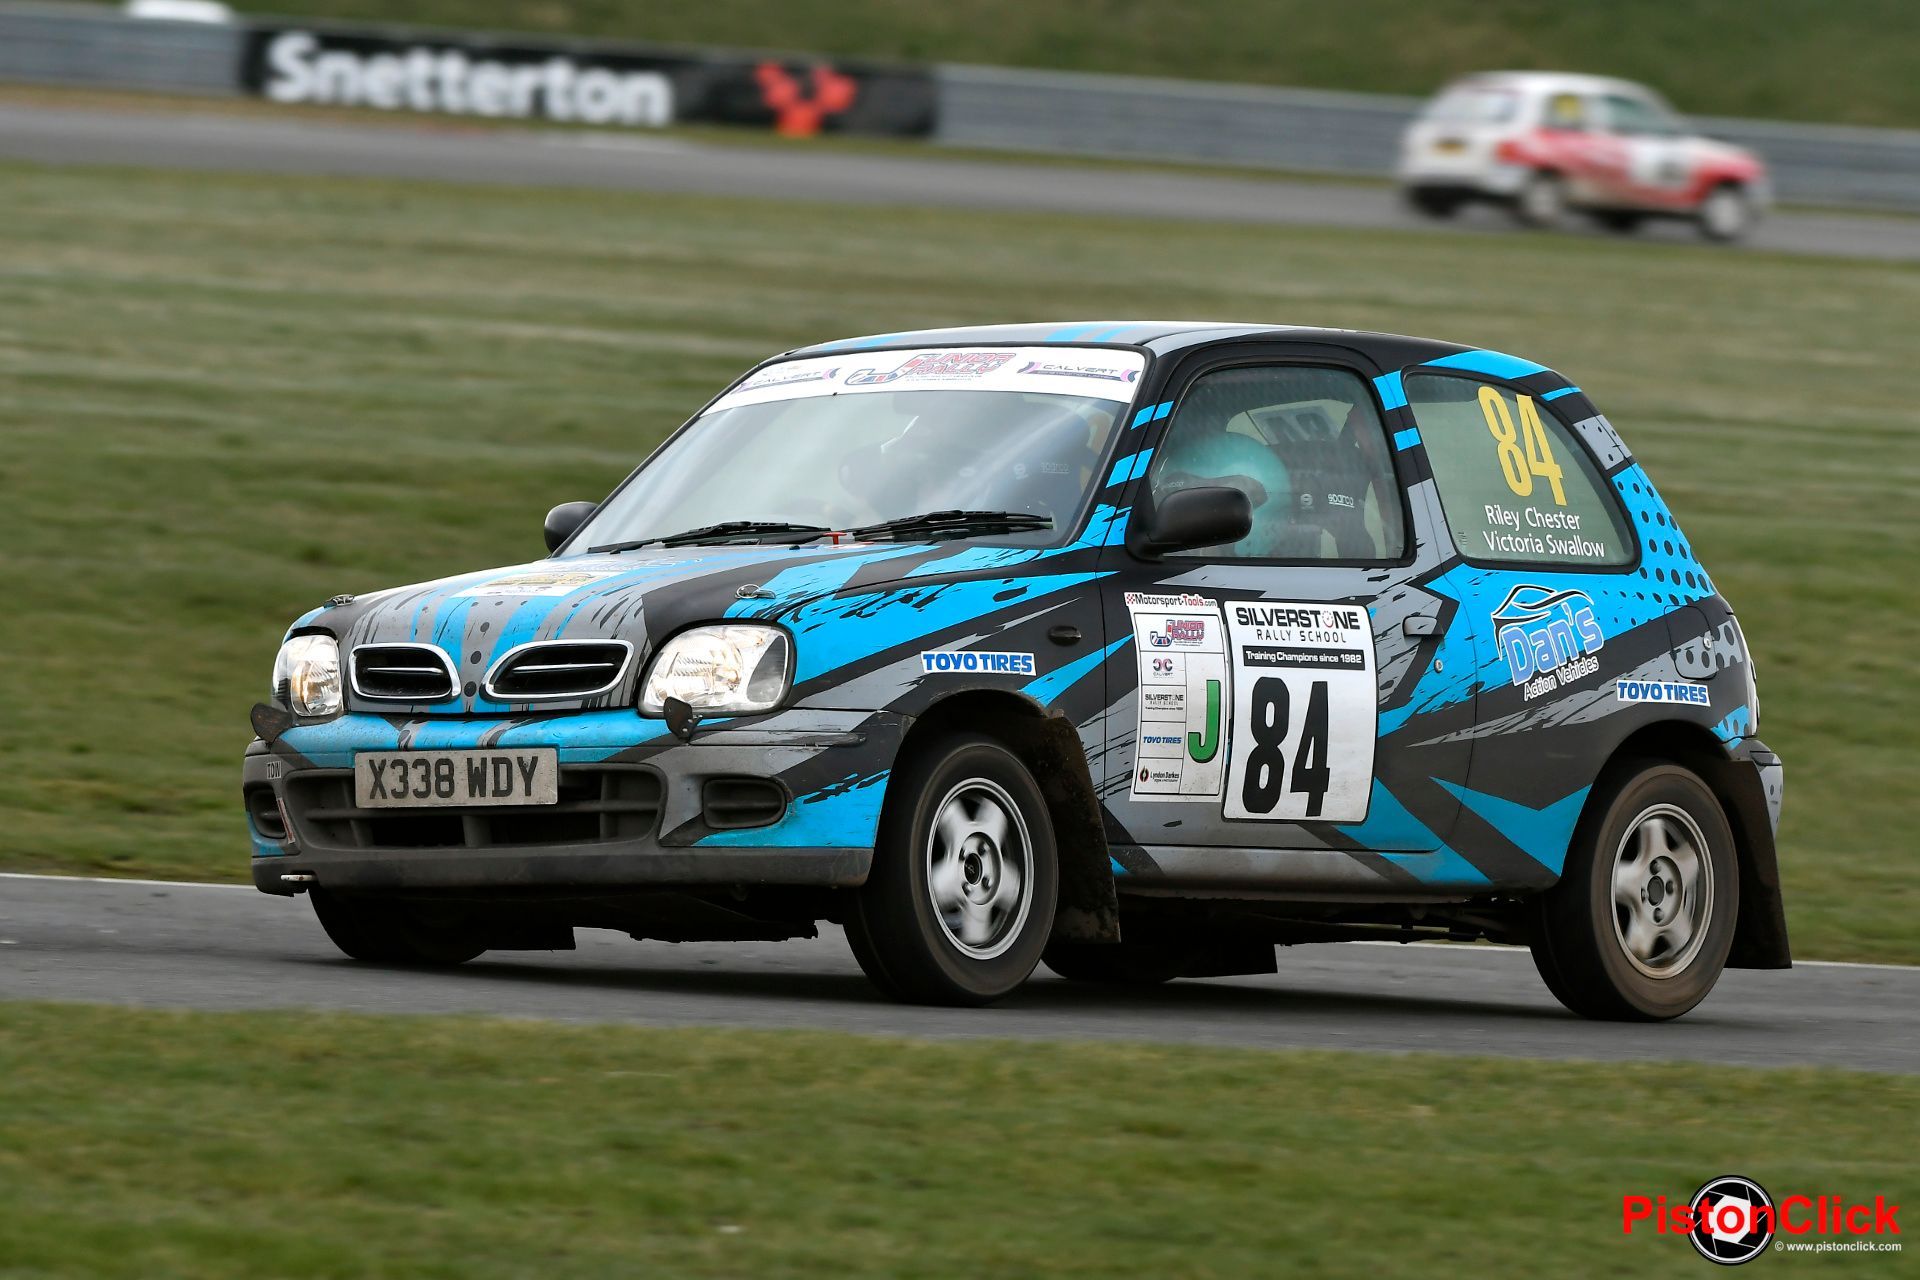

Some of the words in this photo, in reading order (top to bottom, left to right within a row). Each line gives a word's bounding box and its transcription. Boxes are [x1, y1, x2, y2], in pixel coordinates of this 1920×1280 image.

[266, 32, 674, 126] Snetterton
[1043, 364, 1119, 375] CALVERT
[1478, 385, 1567, 506] 84
[1484, 504, 1520, 531] Riley
[1525, 507, 1581, 529] Chester
[1483, 530, 1545, 553] Victoria
[1546, 534, 1604, 557] Swallow
[1235, 606, 1361, 630] SILVERSTONE
[1256, 629, 1291, 641] RALLY
[1299, 631, 1347, 643] SCHOOL
[1500, 602, 1605, 686] Dan's
[923, 652, 978, 671] TOYO
[979, 653, 1033, 673] TIRES
[1245, 650, 1277, 662] Training
[1276, 651, 1319, 663] Champions
[1319, 653, 1339, 663] since
[1340, 653, 1362, 664] 1982
[1524, 674, 1558, 702] Action
[1556, 655, 1599, 686] Vehicles
[1618, 682, 1663, 700] TOYO
[1664, 684, 1708, 704] TIRES
[1187, 679, 1221, 764] J
[1143, 736, 1162, 744] TOYO
[1242, 676, 1331, 817] 84
[267, 762, 281, 778] TOW
[368, 757, 455, 799] X338
[466, 755, 539, 798] WDY
